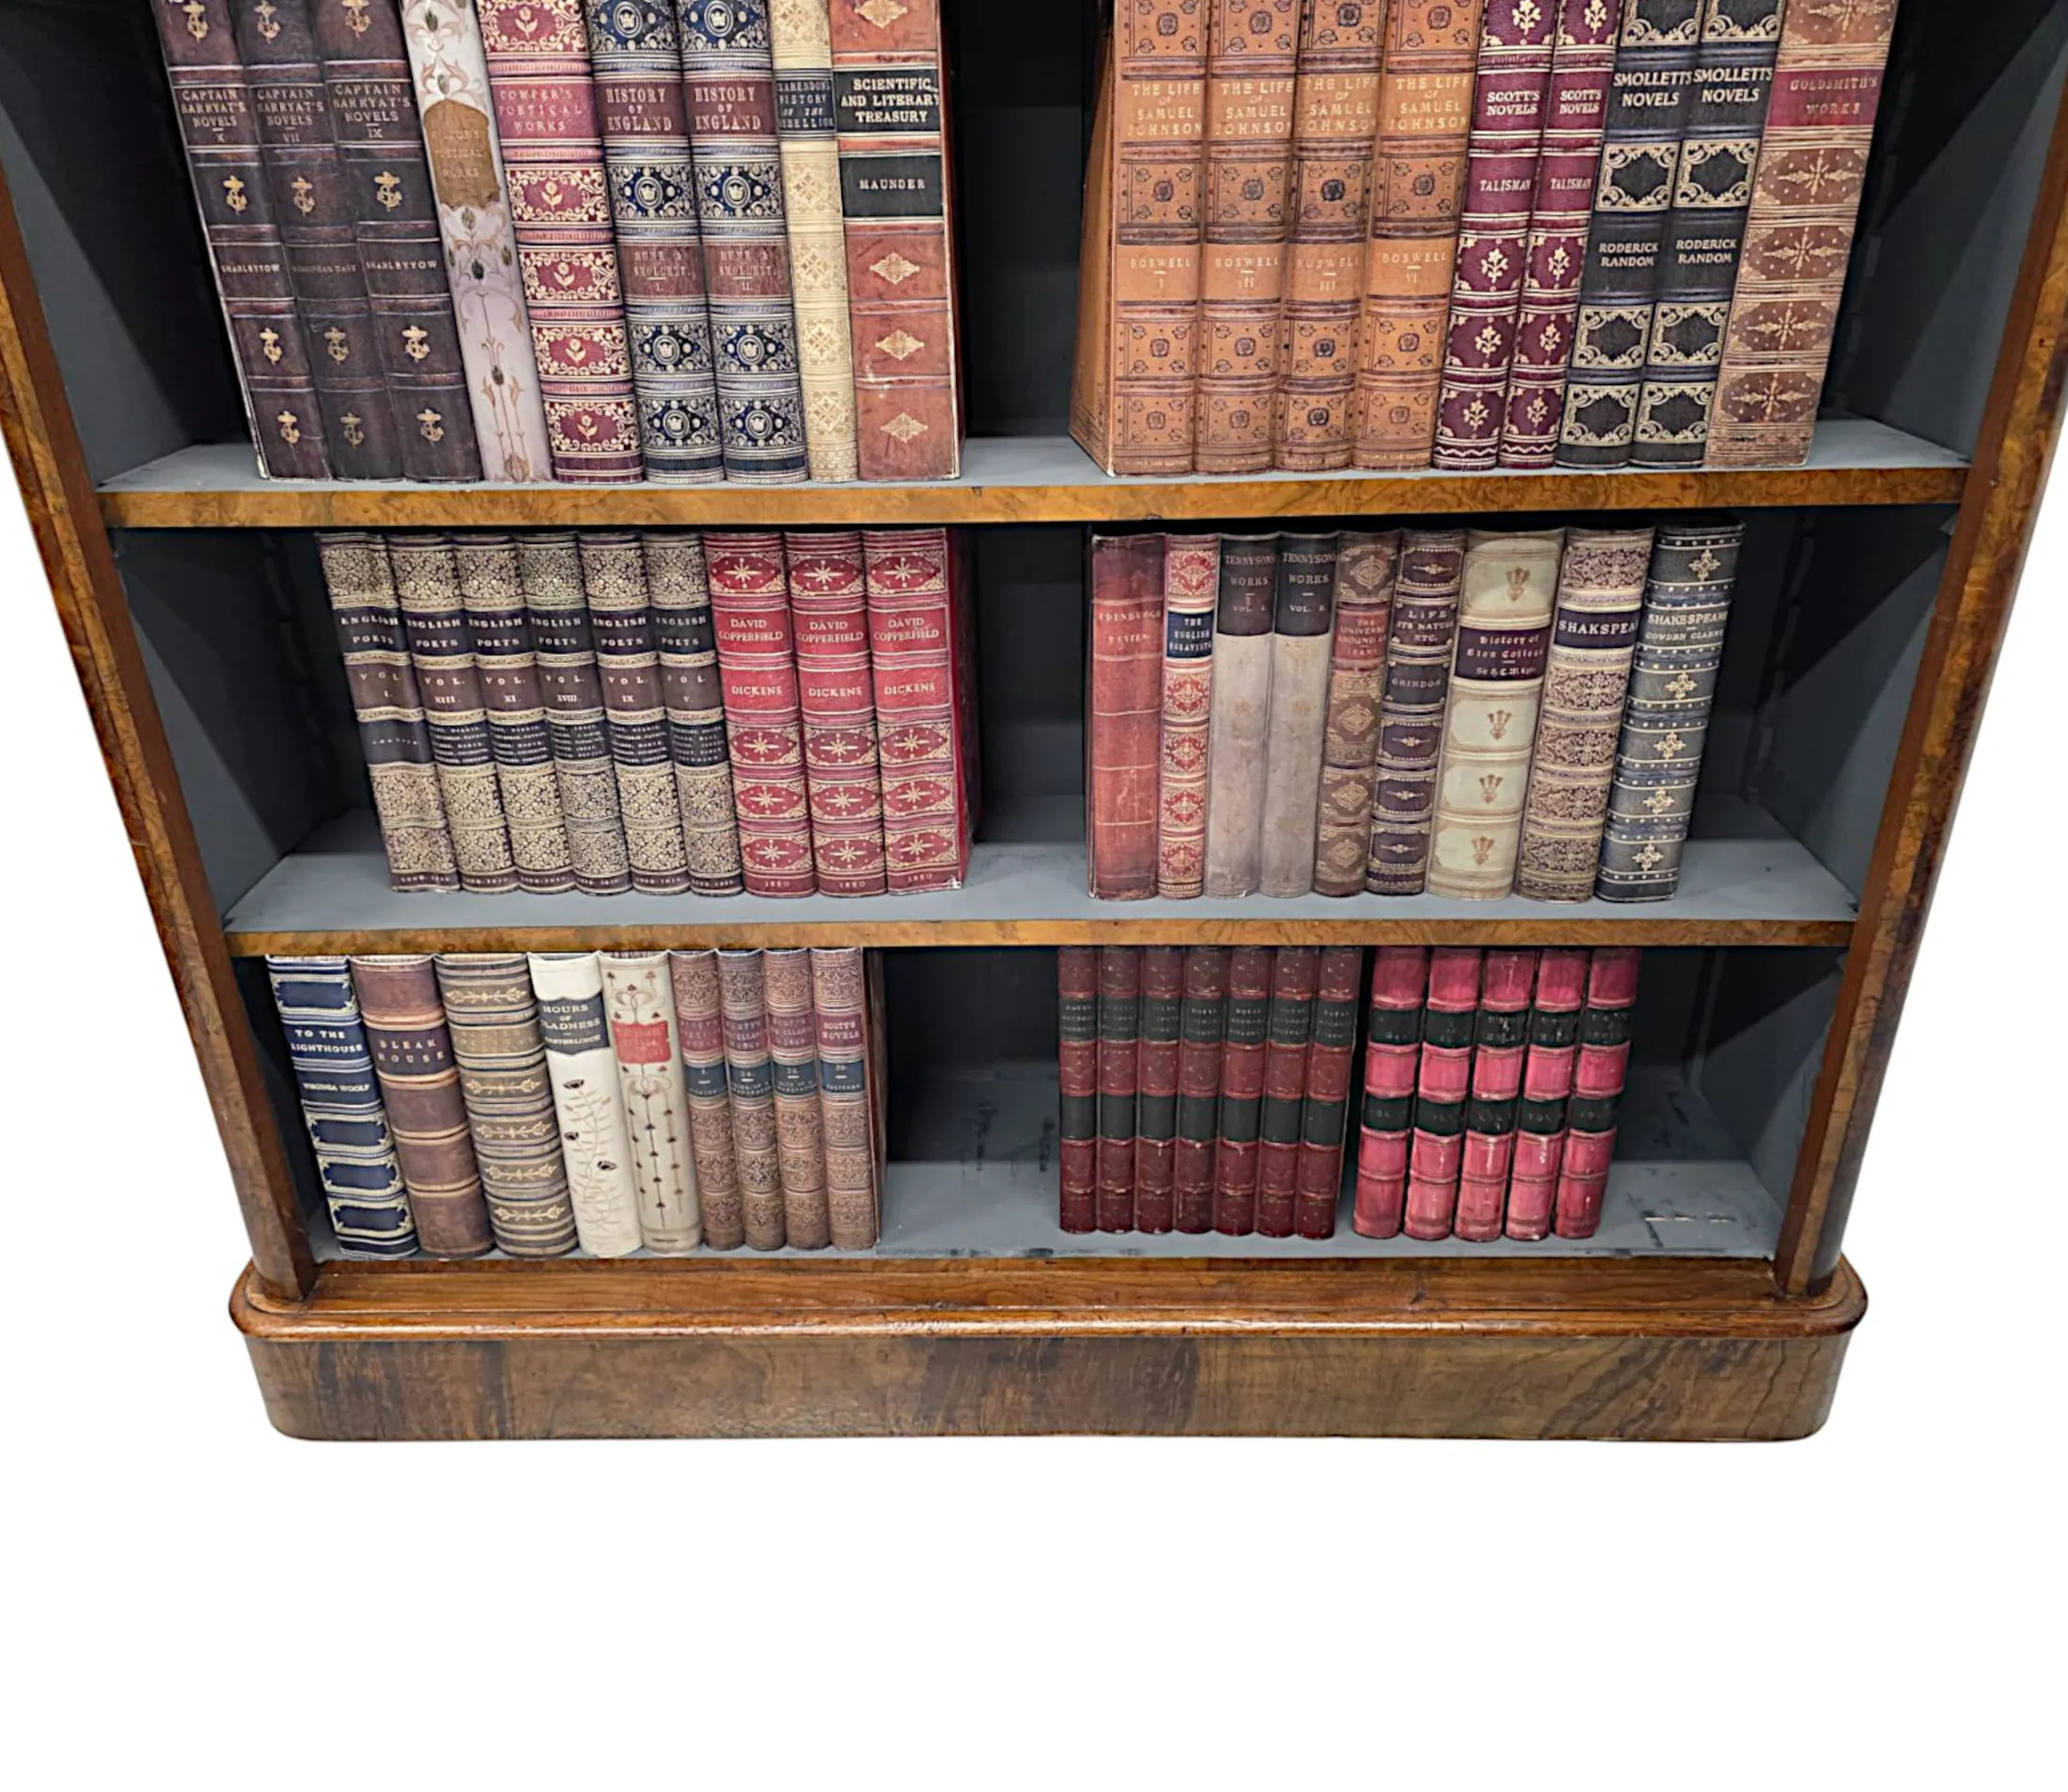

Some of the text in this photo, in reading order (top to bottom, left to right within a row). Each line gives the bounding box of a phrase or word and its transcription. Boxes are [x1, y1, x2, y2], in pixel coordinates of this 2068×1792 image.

[853, 77, 932, 91] SCIENTIFIC
[1132, 82, 1200, 96] THE LIFE
[1221, 81, 1294, 95] THE LIFE
[1305, 76, 1379, 91] THE LIFE
[1395, 76, 1469, 90] THE LIFE
[182, 88, 238, 101] CAPTAIN
[257, 88, 314, 100] CAPTAIN
[335, 85, 402, 95] CAPTAIN
[605, 86, 667, 103] HISTORY
[694, 86, 756, 102] HISTORY
[1701, 87, 1761, 103] NOVELS
[841, 94, 940, 107] AND LITERARY
[1622, 92, 1680, 107] NOVELS
[628, 104, 644, 115] OF
[717, 104, 734, 114] OF
[1137, 106, 1195, 120] SAMUEL
[1226, 105, 1287, 119] SAMUEL
[1309, 102, 1372, 116] SAMUEL
[1400, 100, 1462, 114] SAMUEL
[1486, 103, 1539, 116] NOVELS
[1559, 102, 1600, 115] NOVELS
[1805, 102, 1860, 116] WORKS
[193, 116, 238, 128] NOVELS
[267, 114, 313, 126] NOVELS
[345, 111, 400, 122] NOVELS
[854, 110, 930, 123] TREASURY
[514, 120, 566, 132] WORKS
[607, 117, 673, 132] ENGLAND
[695, 115, 762, 131] ENGLAND
[859, 179, 926, 190] MAUNDER
[1599, 242, 1659, 254] RODERICK
[1675, 239, 1737, 250] RODERICK
[1382, 251, 1447, 263] BOSWELL
[1601, 256, 1654, 268] RANDOM
[1678, 253, 1732, 264] RANDOM
[1130, 258, 1193, 269] BOSWELL
[1230, 575, 1269, 587] WORKS
[1289, 574, 1330, 585] WORKS
[340, 614, 400, 626] ENGLISH
[1407, 610, 1449, 621] LIFE
[729, 618, 768, 629] DAVID
[808, 621, 849, 631] DAVID
[887, 617, 926, 628] DAVID
[1184, 617, 1202, 627] THE
[718, 631, 784, 642] COPPERFIELD
[796, 631, 865, 644] COPPERFIELD
[873, 629, 940, 641] COPPERFIELD
[1646, 631, 1685, 642] COWDEN
[415, 638, 460, 649] POETS
[477, 638, 521, 648] POETS
[539, 637, 578, 647] POETS
[601, 637, 644, 647] POETS
[661, 637, 699, 647] POETS
[731, 684, 783, 697] DICKENS
[807, 686, 863, 698] DICKENS
[884, 683, 935, 695] DICKENS
[542, 1005, 589, 1014] HOURS
[294, 1030, 346, 1039] TO THE
[290, 1043, 363, 1054] LIGHTHOUSE
[380, 1039, 437, 1049] BLEAK
[378, 1051, 445, 1063] HOUSE
